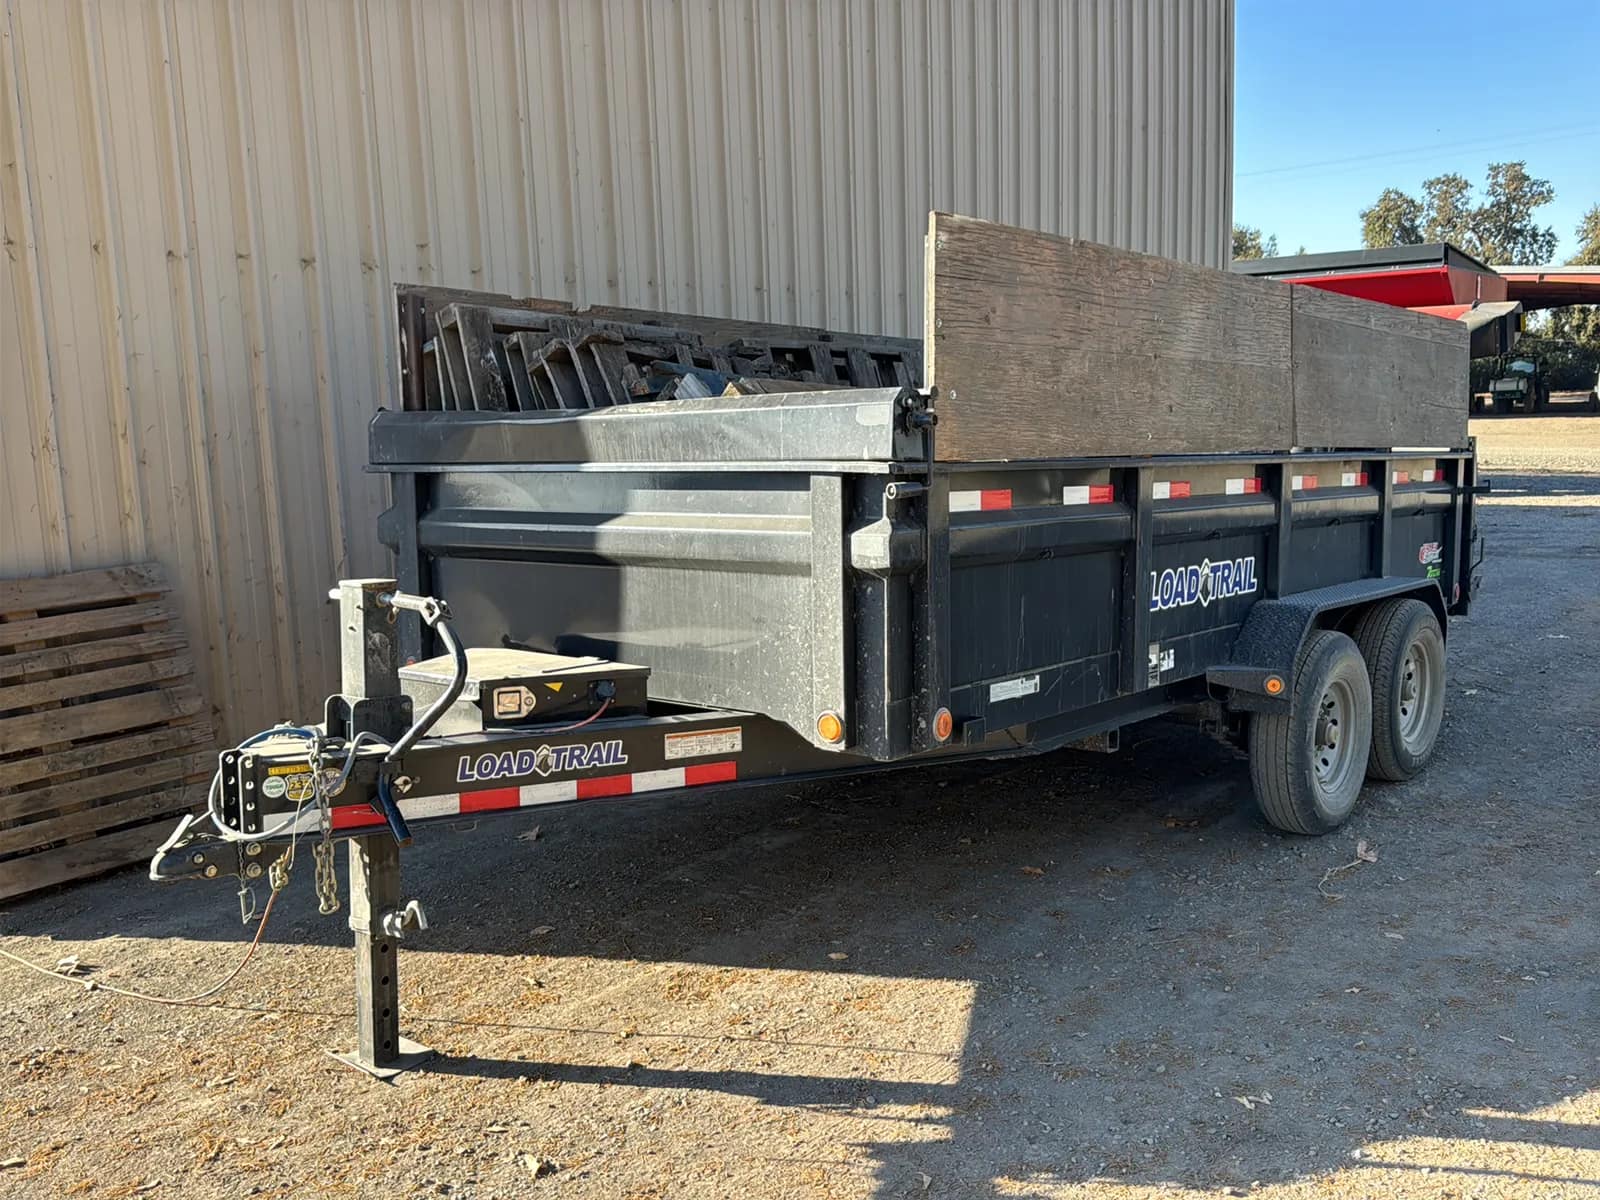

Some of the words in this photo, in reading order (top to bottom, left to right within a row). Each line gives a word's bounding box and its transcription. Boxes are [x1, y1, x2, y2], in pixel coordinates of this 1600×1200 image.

[1209, 557, 1257, 600] TRAIL
[457, 750, 537, 782] LOAD
[550, 740, 628, 772] TRAIL
